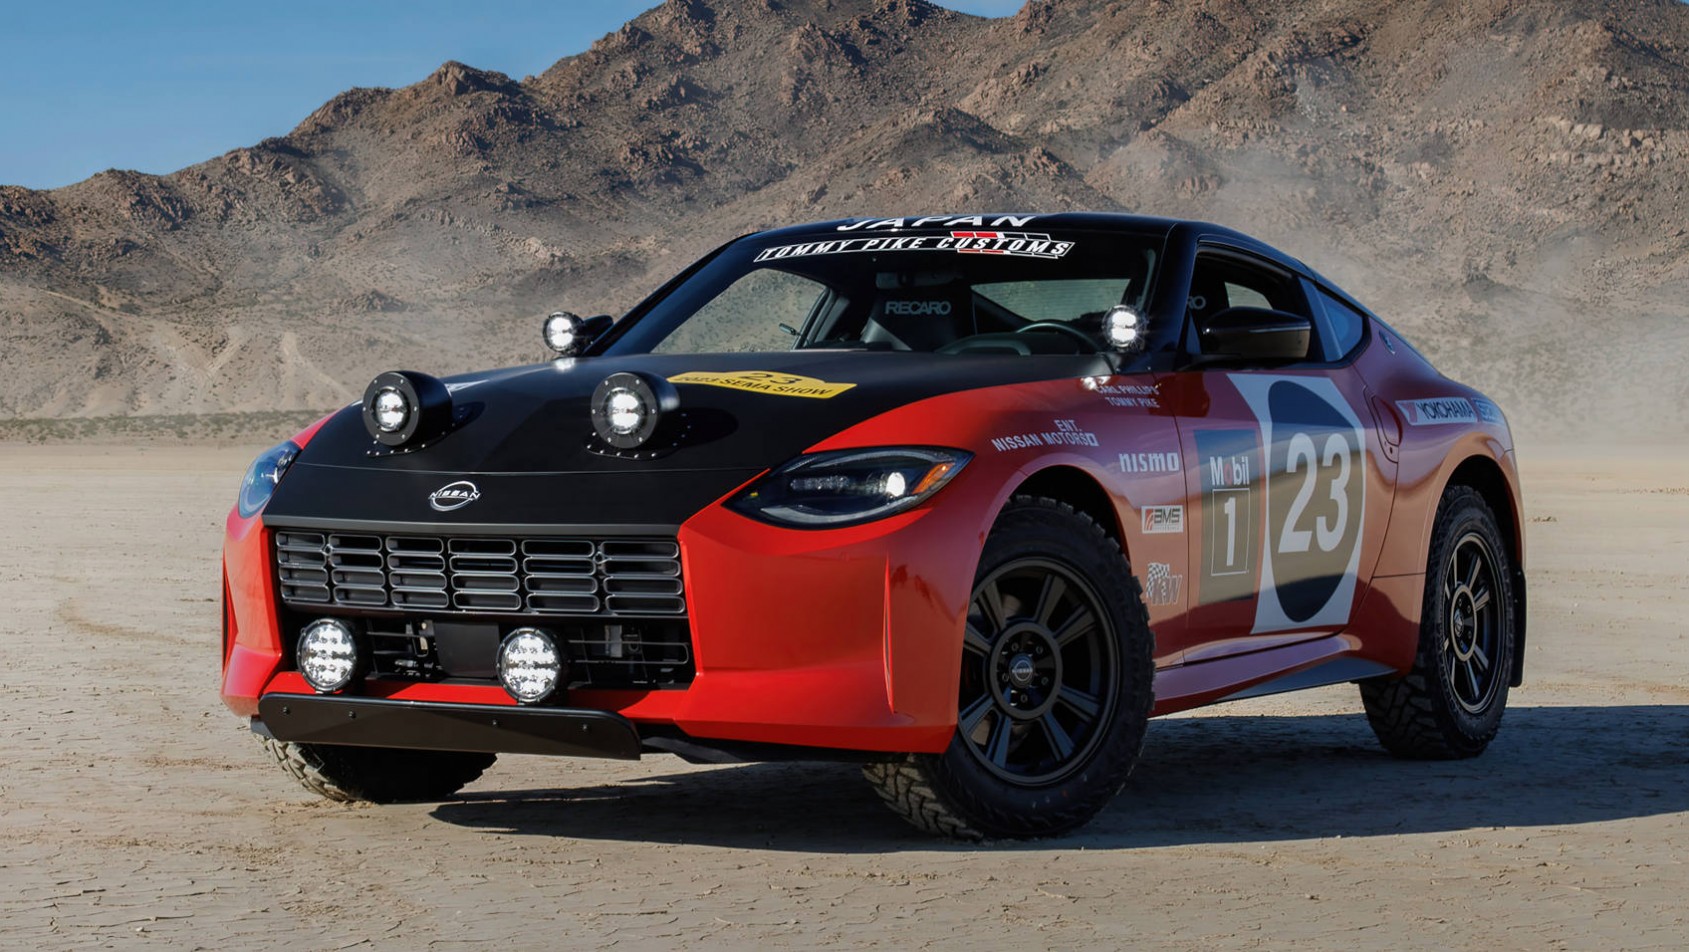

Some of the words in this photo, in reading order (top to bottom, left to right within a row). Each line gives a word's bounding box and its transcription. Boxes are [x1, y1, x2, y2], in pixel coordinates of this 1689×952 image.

[837, 215, 1037, 231] JAPAN
[763, 240, 852, 260] TOMMY
[862, 237, 929, 250] PIKE
[936, 237, 1072, 256] CUSTOMS
[885, 300, 951, 315] RECARO
[721, 378, 770, 392] SEMA
[774, 385, 833, 396] SHOW
[739, 372, 803, 385] 23
[1416, 400, 1474, 420] YOKOHAMA
[1054, 419, 1082, 432] ENT.
[991, 432, 1043, 452] NISSAN
[1041, 432, 1088, 446] MOTORS
[1119, 452, 1180, 473] nismo
[1209, 456, 1249, 486] Mobil
[428, 490, 480, 501] NISSAN
[1278, 432, 1351, 554] 23
[1224, 497, 1237, 566] 1
